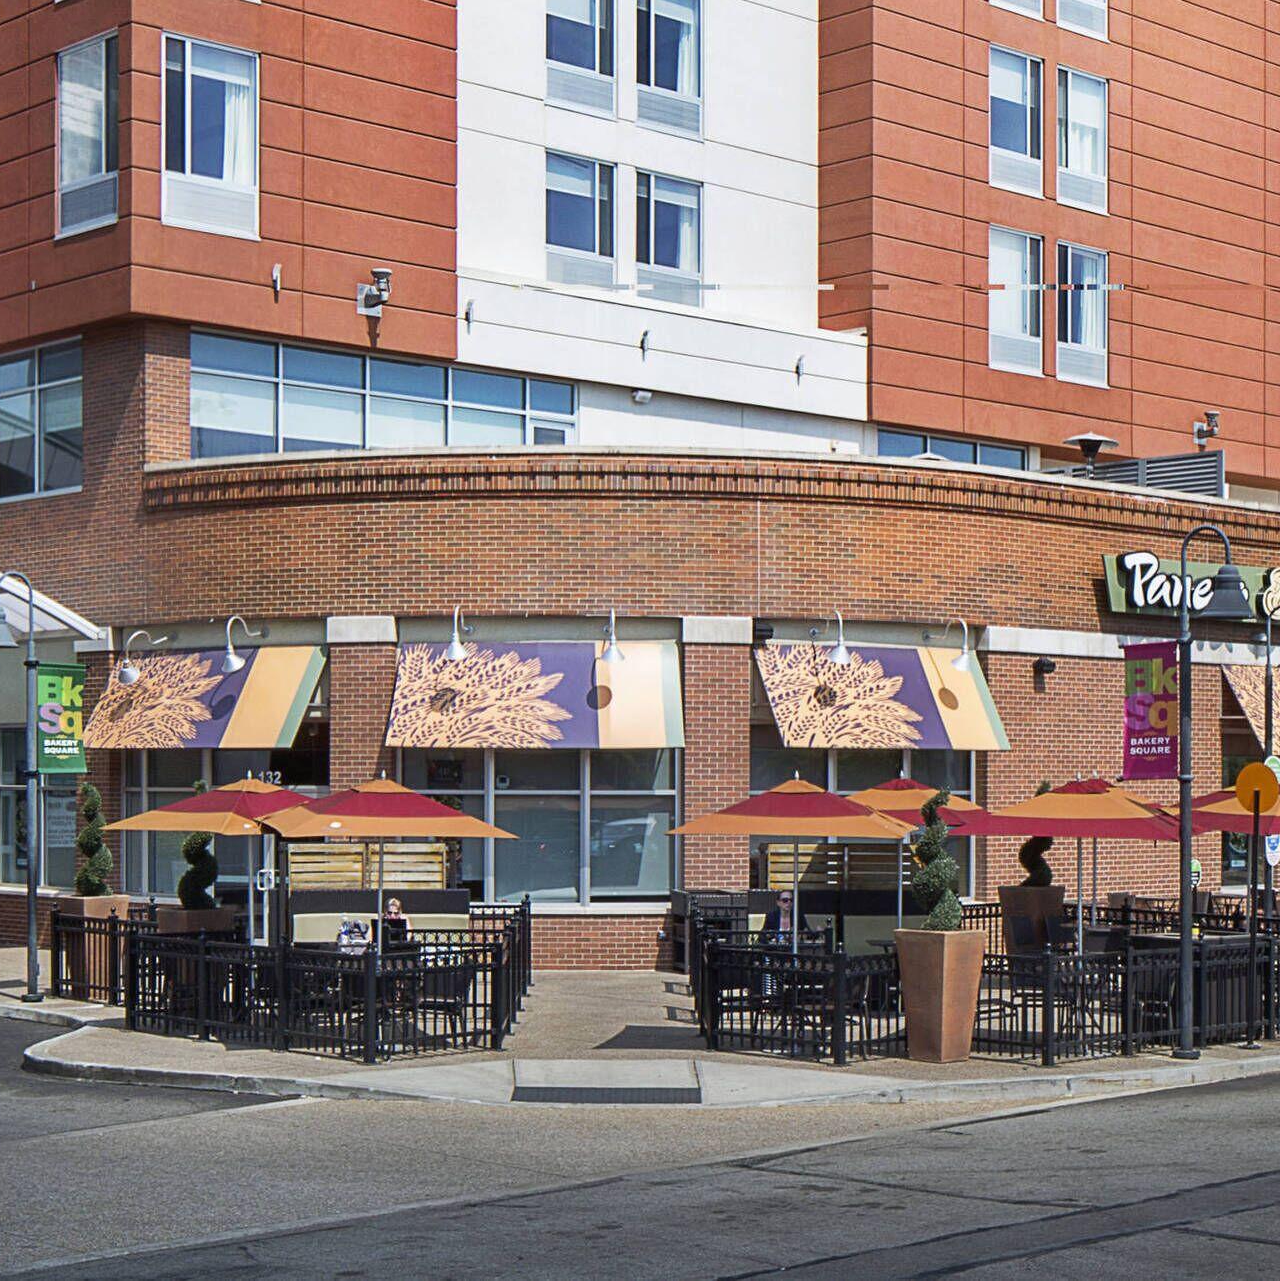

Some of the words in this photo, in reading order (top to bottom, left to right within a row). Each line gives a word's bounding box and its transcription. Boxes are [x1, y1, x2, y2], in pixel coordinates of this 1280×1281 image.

[1124, 552, 1249, 610] Pane
[38, 675, 84, 707] Bk
[1125, 658, 1178, 697] Bk
[39, 702, 83, 740] Sq
[1127, 692, 1178, 736] Sq
[43, 739, 79, 747] BAKERY
[1130, 737, 1171, 746] BAKERY
[1130, 746, 1171, 755] SQUARE
[258, 770, 282, 785] 132
